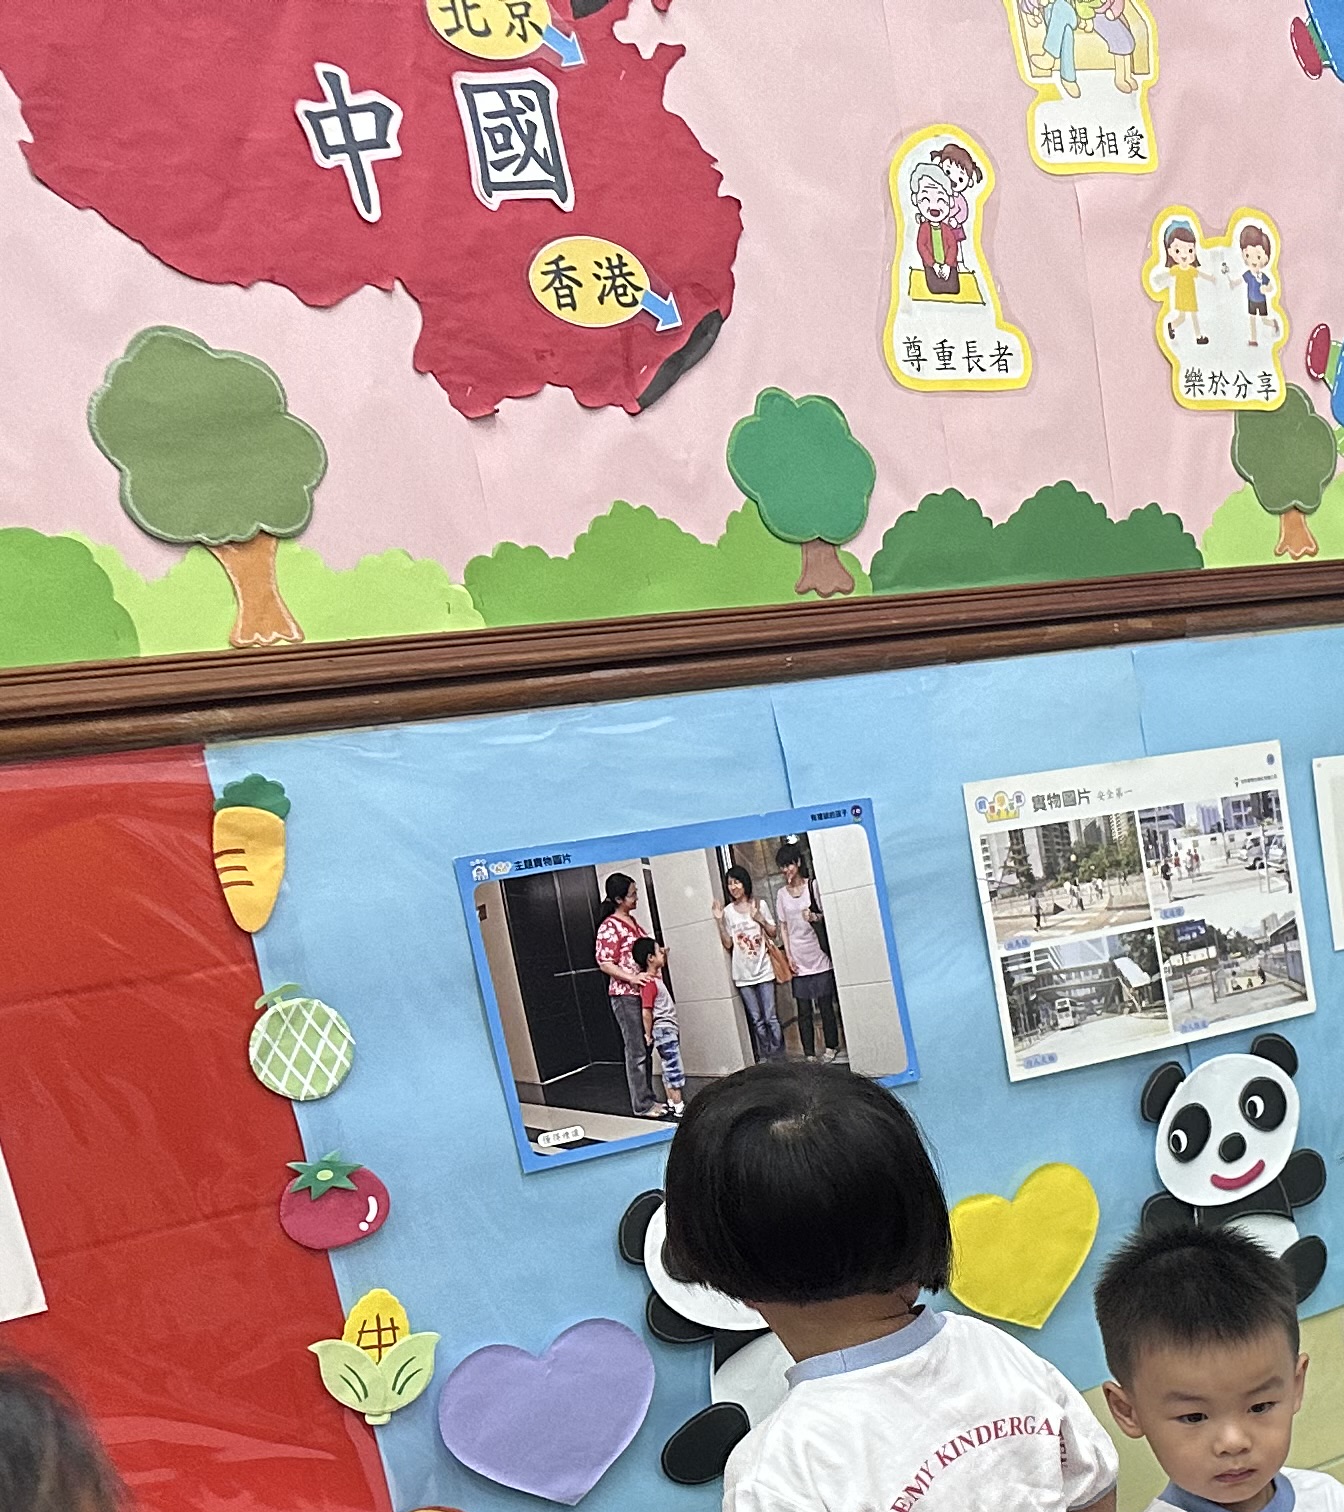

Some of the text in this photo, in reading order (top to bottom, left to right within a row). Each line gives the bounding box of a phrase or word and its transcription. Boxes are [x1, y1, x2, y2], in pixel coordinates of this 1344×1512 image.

[442, 0, 545, 41] 北京
[305, 70, 573, 215] 中國
[1040, 124, 1148, 161] 相親相愛
[539, 255, 644, 312] 香港
[901, 336, 1013, 375] 尊重長者
[1183, 366, 1278, 403] 樂於分享
